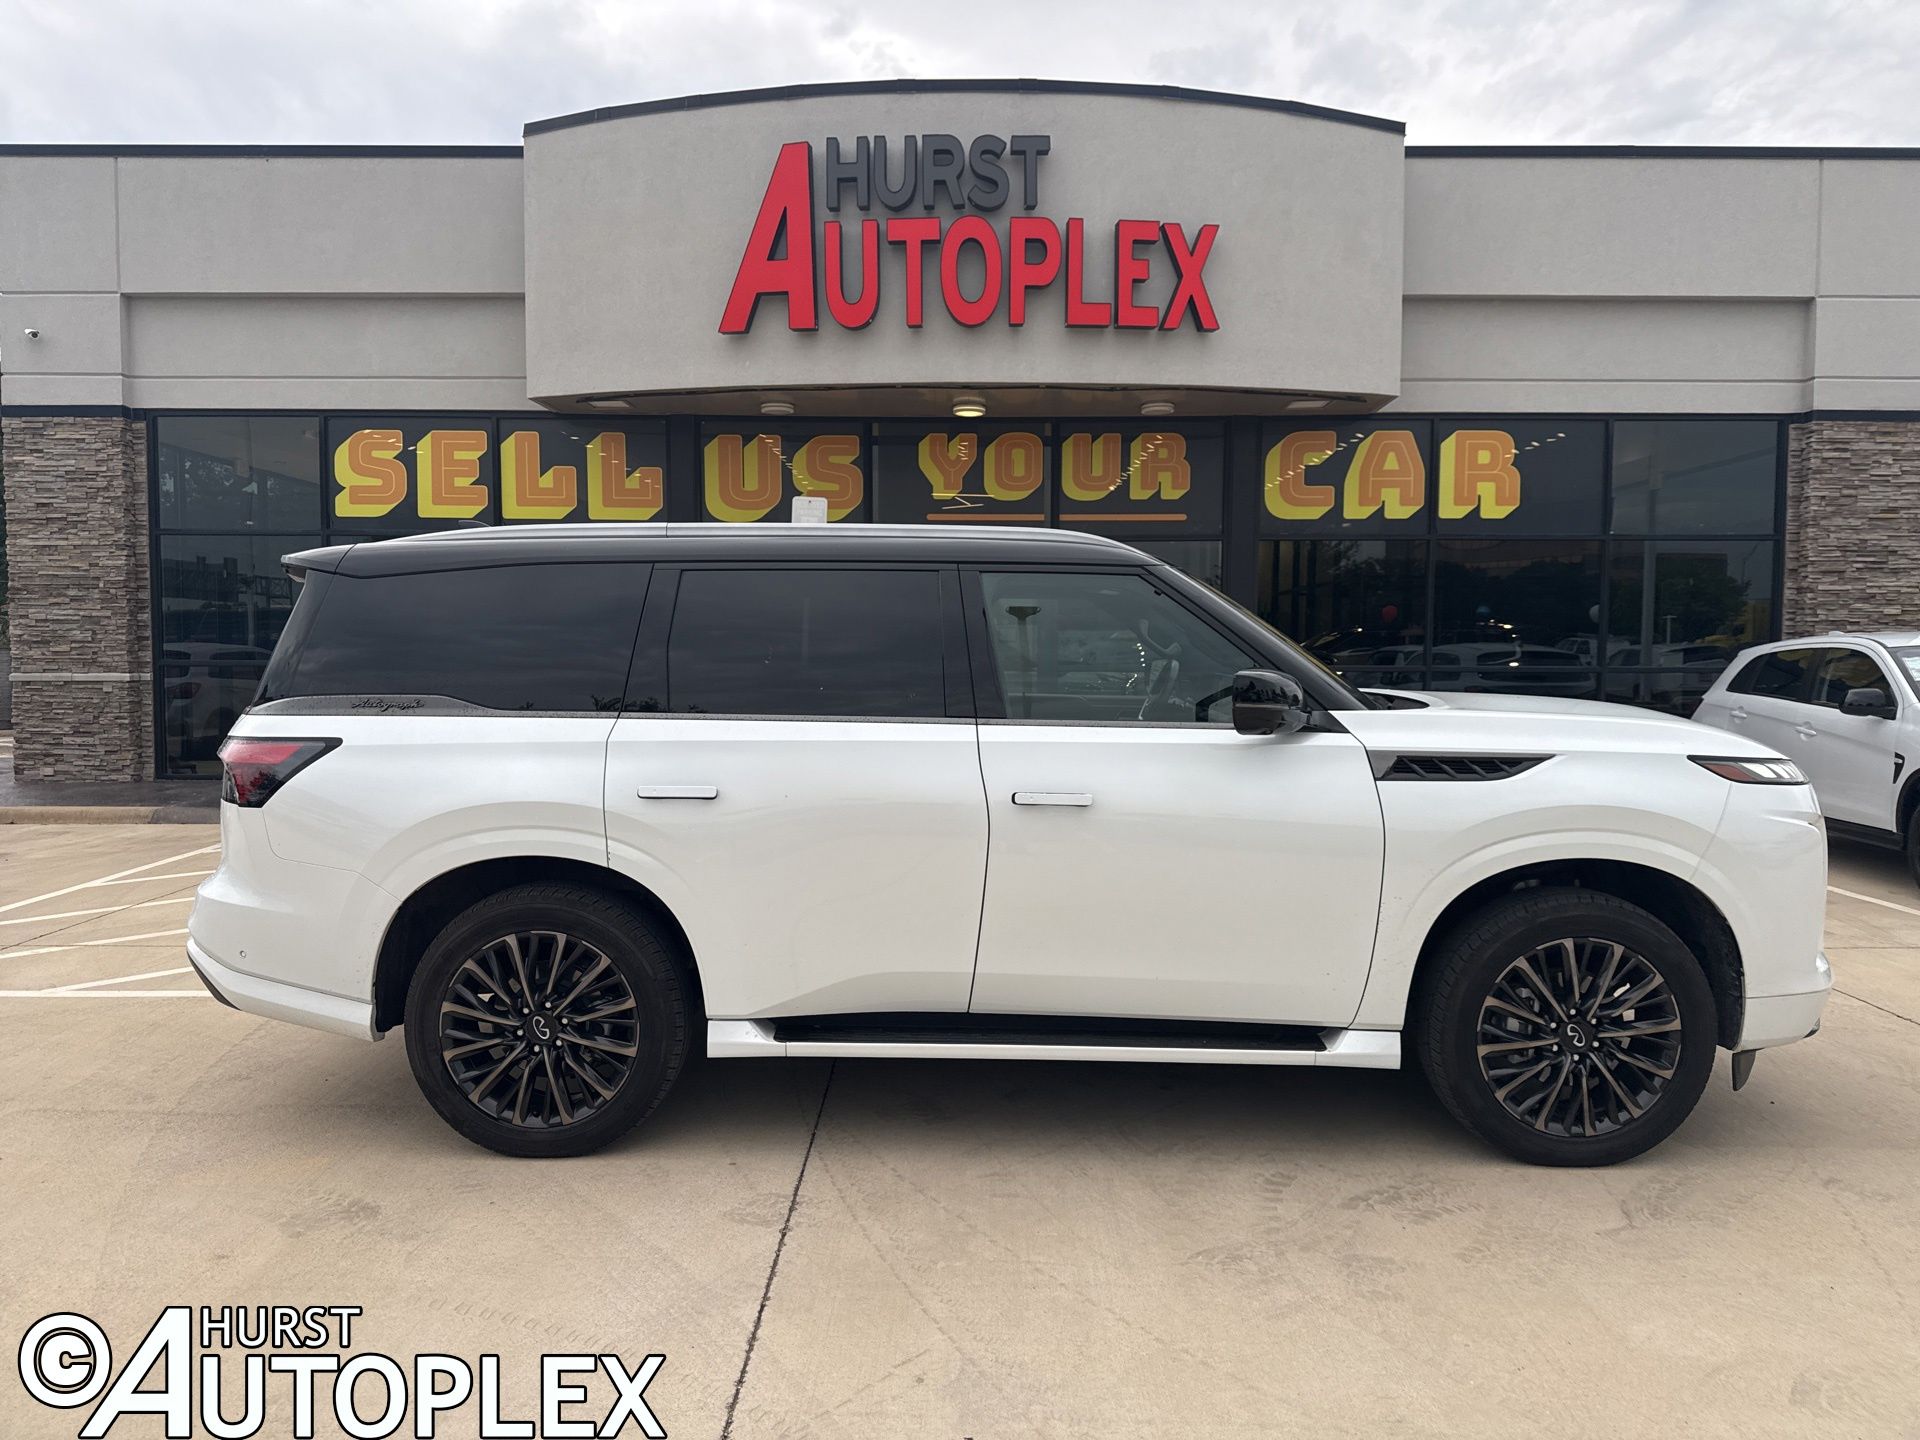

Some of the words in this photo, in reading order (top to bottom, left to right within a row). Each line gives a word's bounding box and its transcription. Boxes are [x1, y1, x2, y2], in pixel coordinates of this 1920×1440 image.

[826, 134, 1051, 211] HURST
[718, 141, 1221, 334] AUTOPLEX
[334, 430, 664, 520] SELL
[704, 433, 864, 522] US
[918, 431, 1191, 502] YOUR
[1264, 430, 1521, 520] CAR
[351, 698, 425, 712] Autograph
